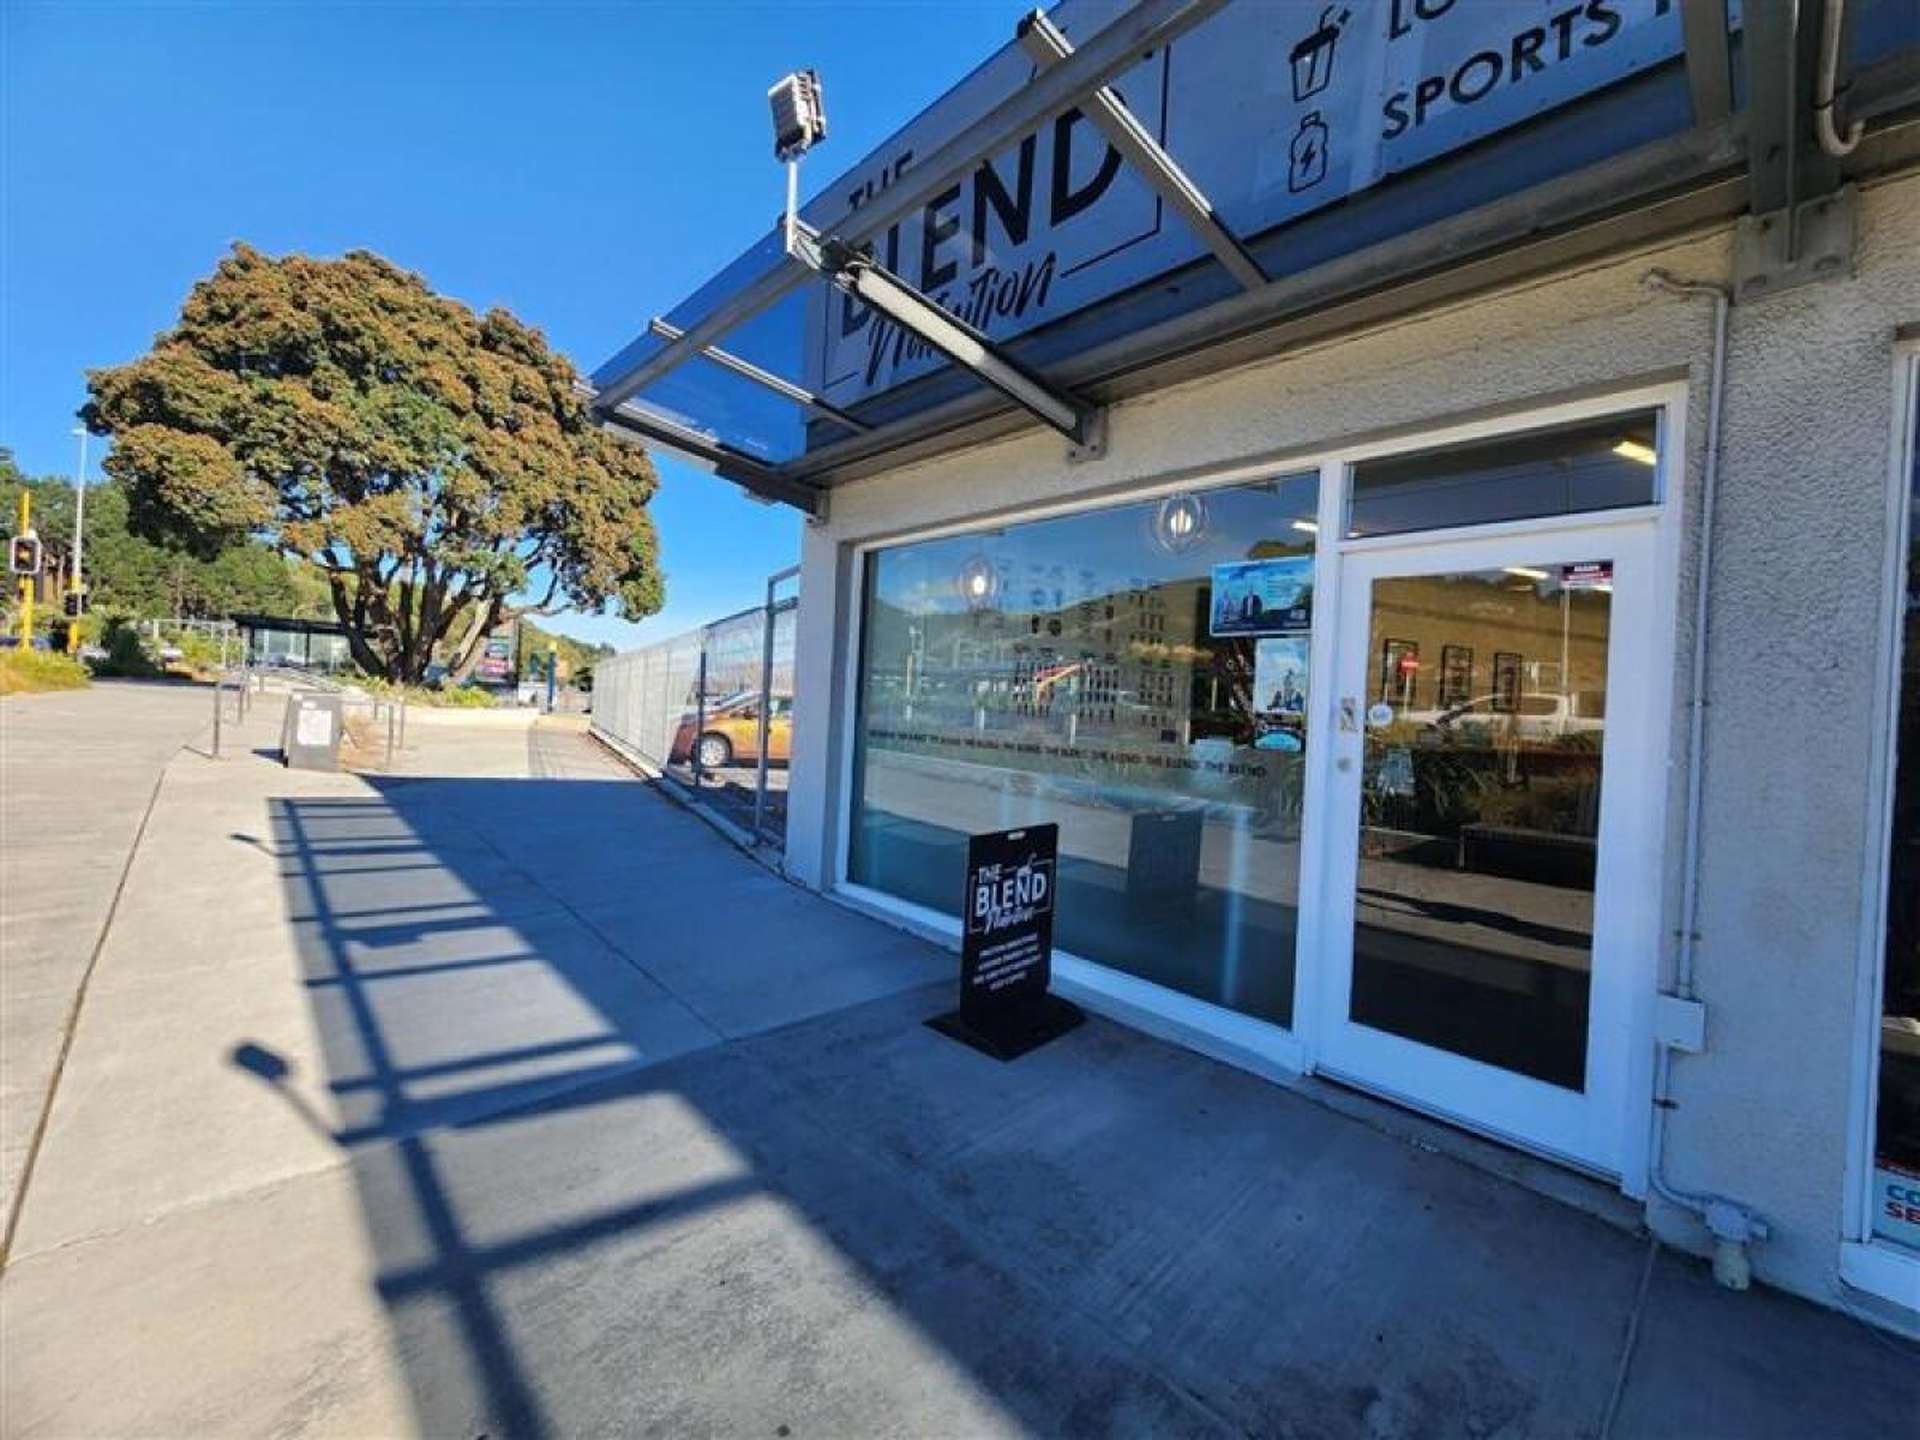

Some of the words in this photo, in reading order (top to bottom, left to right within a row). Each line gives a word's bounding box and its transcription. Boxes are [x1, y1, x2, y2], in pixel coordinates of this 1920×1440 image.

[1381, 0, 1623, 140] SPORTS
[841, 84, 1127, 337] END
[975, 873, 1048, 918] BLEND
[978, 863, 1003, 884] THE
